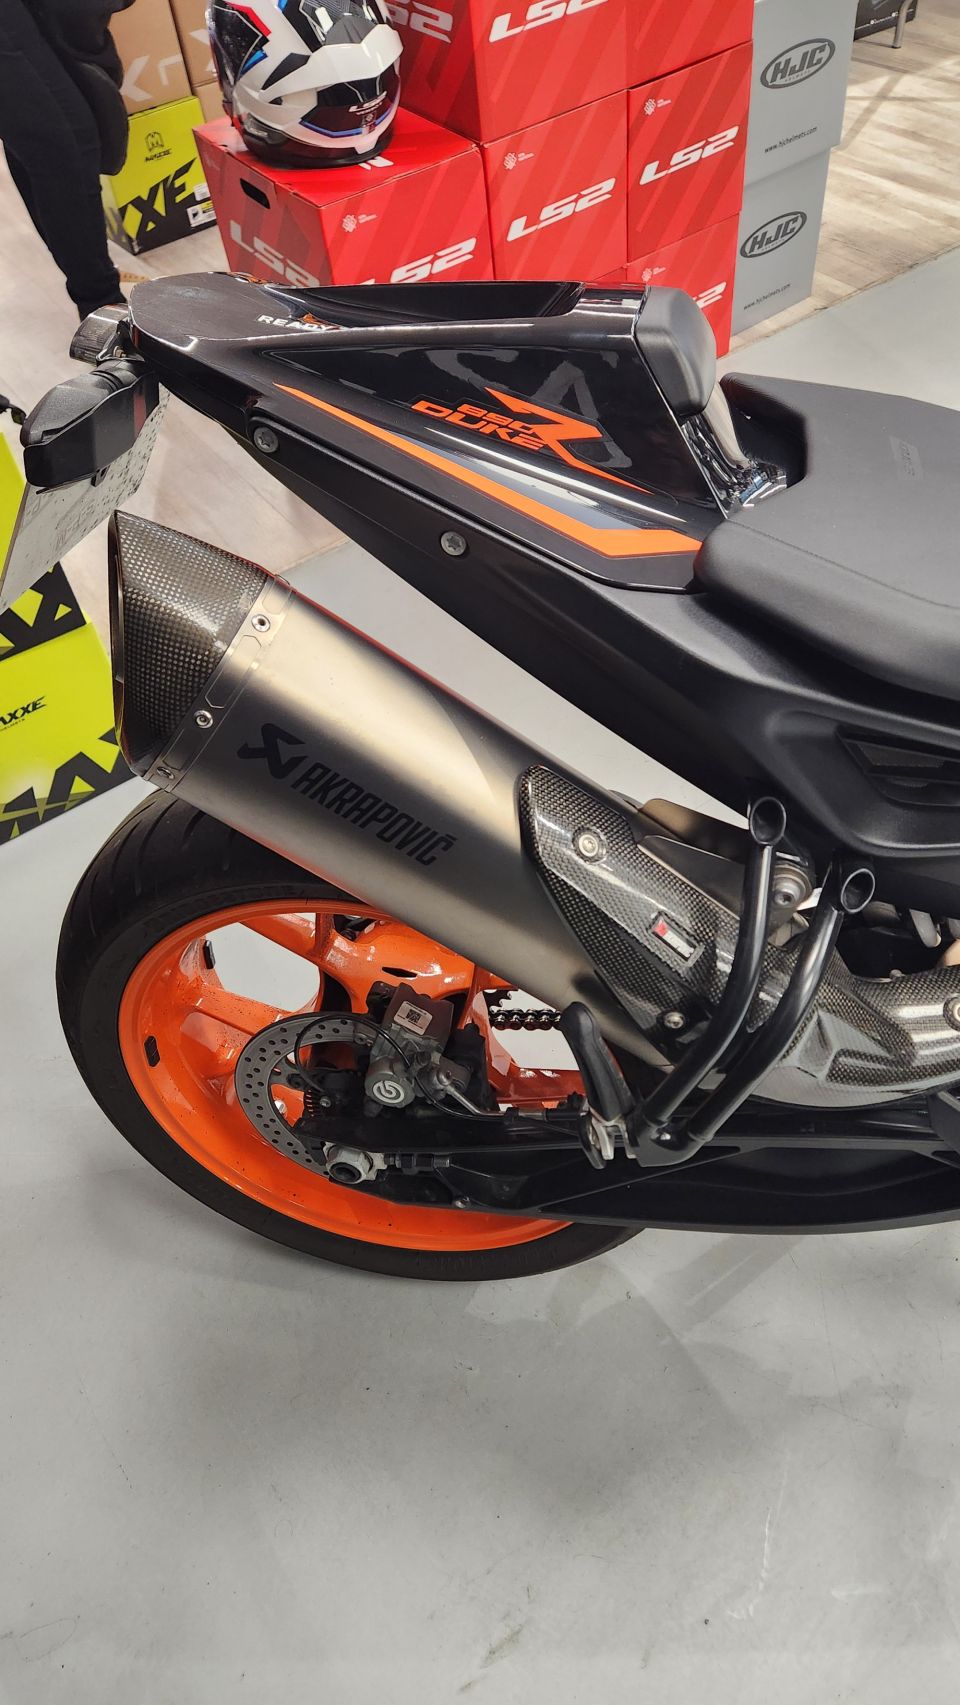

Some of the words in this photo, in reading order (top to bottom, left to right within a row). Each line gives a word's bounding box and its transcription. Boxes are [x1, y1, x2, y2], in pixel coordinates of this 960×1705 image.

[769, 43, 827, 83] HJC
[639, 126, 739, 185] LS2
[507, 177, 616, 242] LS2
[749, 215, 799, 254] HJC
[360, 237, 477, 285] S2
[410, 400, 545, 450] DUKE
[291, 762, 458, 866] AKRAPOVIČ
